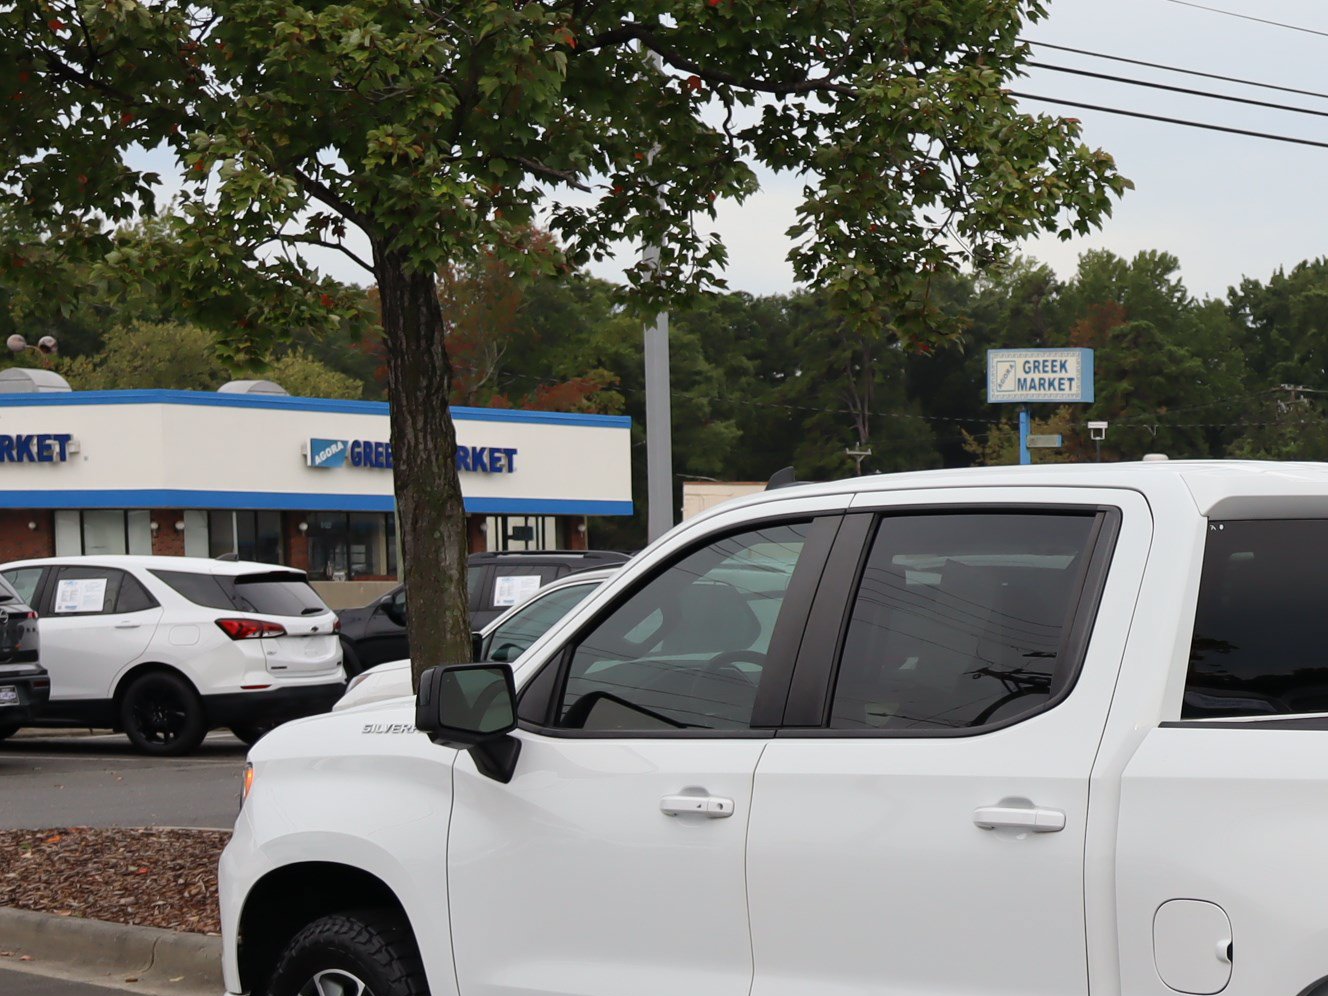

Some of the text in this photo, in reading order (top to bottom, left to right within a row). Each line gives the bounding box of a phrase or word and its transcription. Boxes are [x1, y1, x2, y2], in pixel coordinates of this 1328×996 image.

[1022, 360, 1068, 374] GREEK
[1017, 378, 1075, 392] MARKET
[0, 434, 72, 463] RKET
[314, 439, 518, 473] AGORA GREE RKET
[362, 724, 417, 734] SILVER
